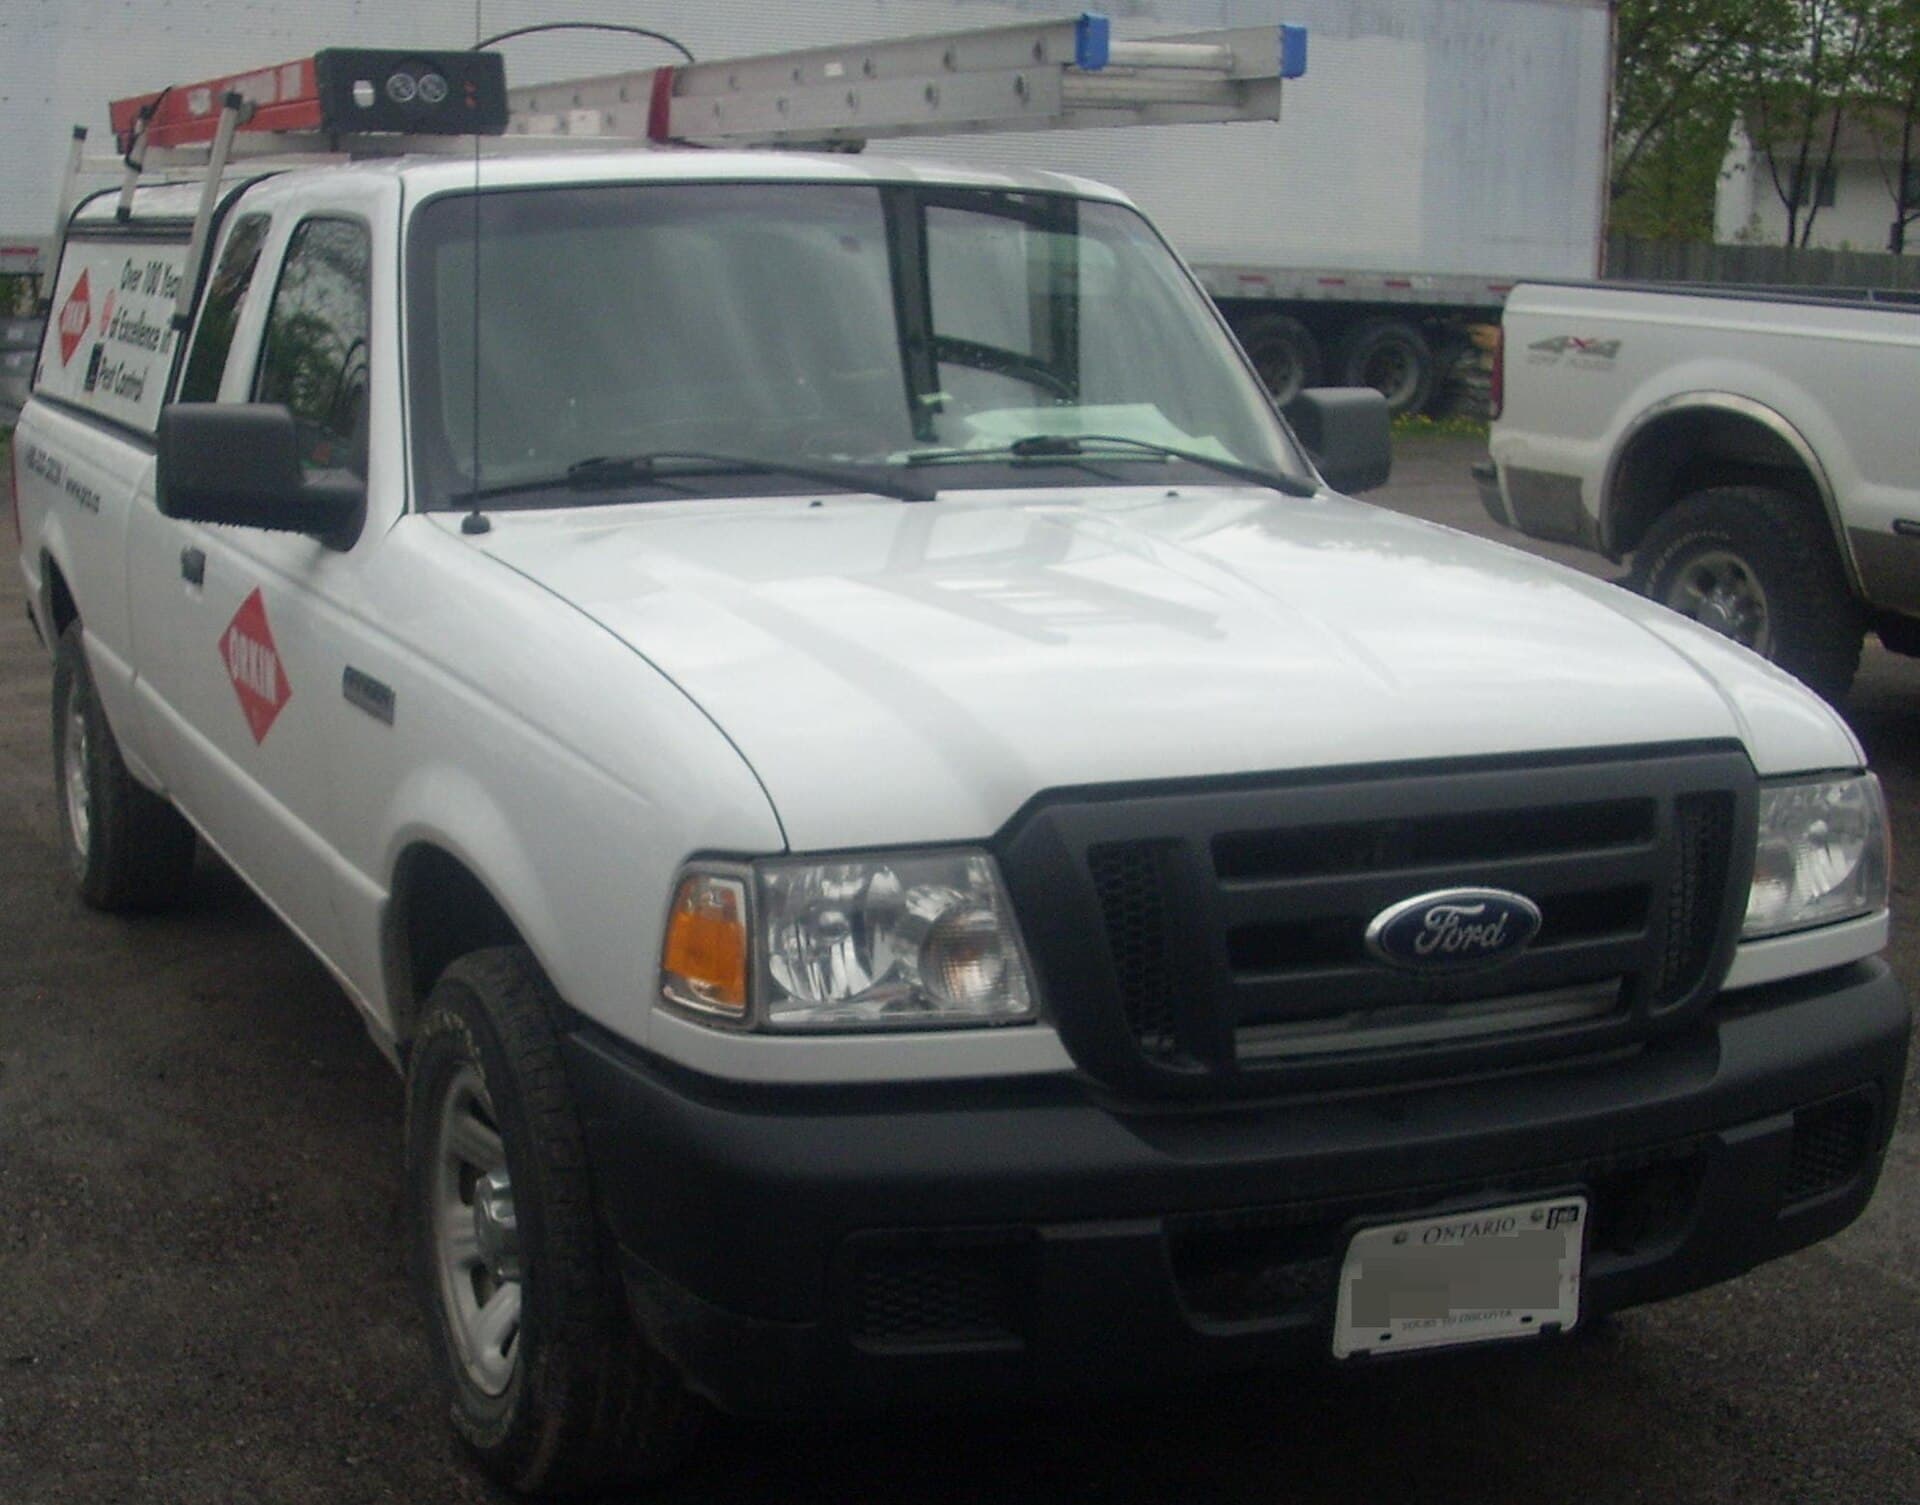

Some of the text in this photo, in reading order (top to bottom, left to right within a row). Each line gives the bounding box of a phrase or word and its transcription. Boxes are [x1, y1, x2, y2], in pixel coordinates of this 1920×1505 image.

[120, 257, 183, 299] Over 100 Yea
[117, 307, 162, 352] Excellence
[98, 356, 149, 403] Pest Control
[229, 624, 278, 705] ORKIN
[1415, 903, 1509, 954] Ford
